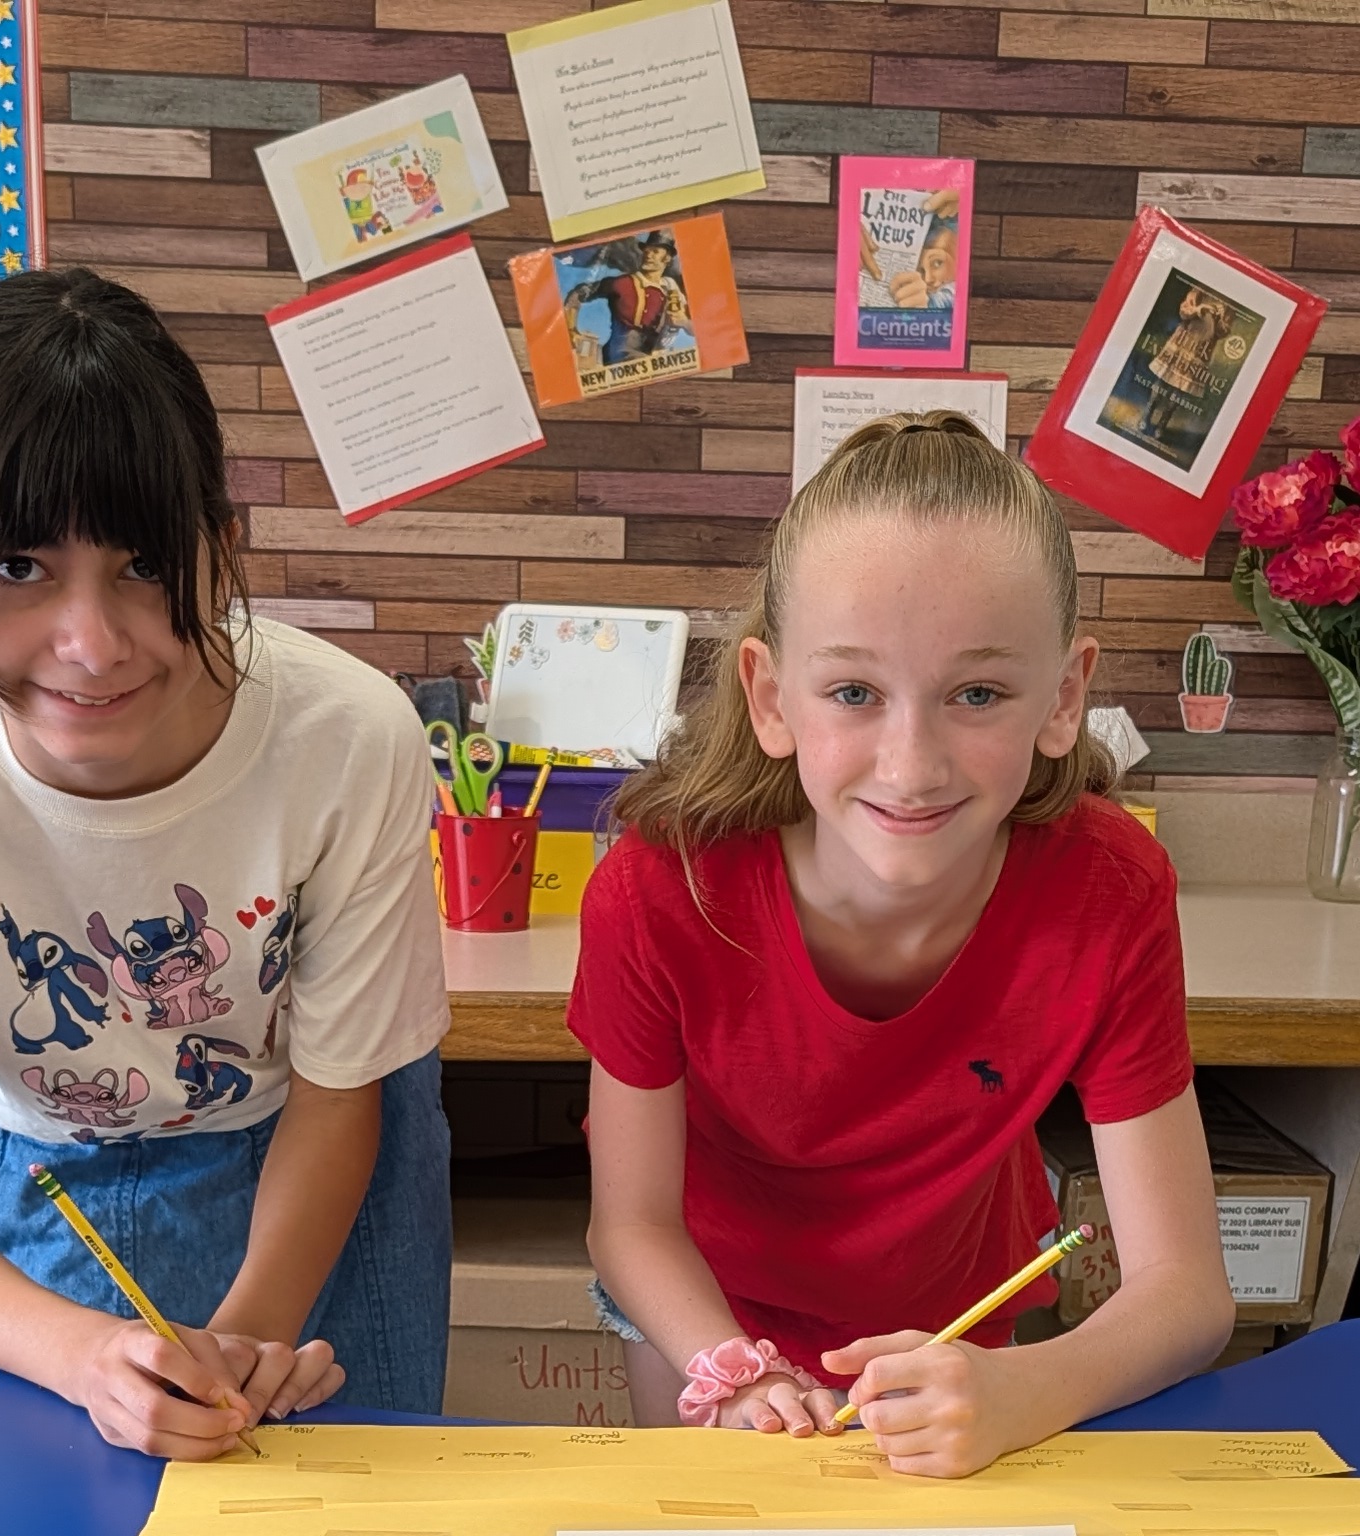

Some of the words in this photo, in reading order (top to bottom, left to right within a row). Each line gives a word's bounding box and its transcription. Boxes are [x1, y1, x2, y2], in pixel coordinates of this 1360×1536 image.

[883, 190, 907, 203] THE
[862, 191, 927, 227] LANDRY
[870, 222, 916, 248] NEWS
[859, 314, 952, 337] Clements
[580, 368, 607, 387] NEW
[609, 361, 648, 380] YORK'S
[651, 349, 697, 371] BRAVEST
[852, 391, 874, 401] News
[1244, 1206, 1290, 1215] COMPANY
[1248, 1219, 1282, 1227] LIBRARY
[518, 1345, 630, 1391] Units
